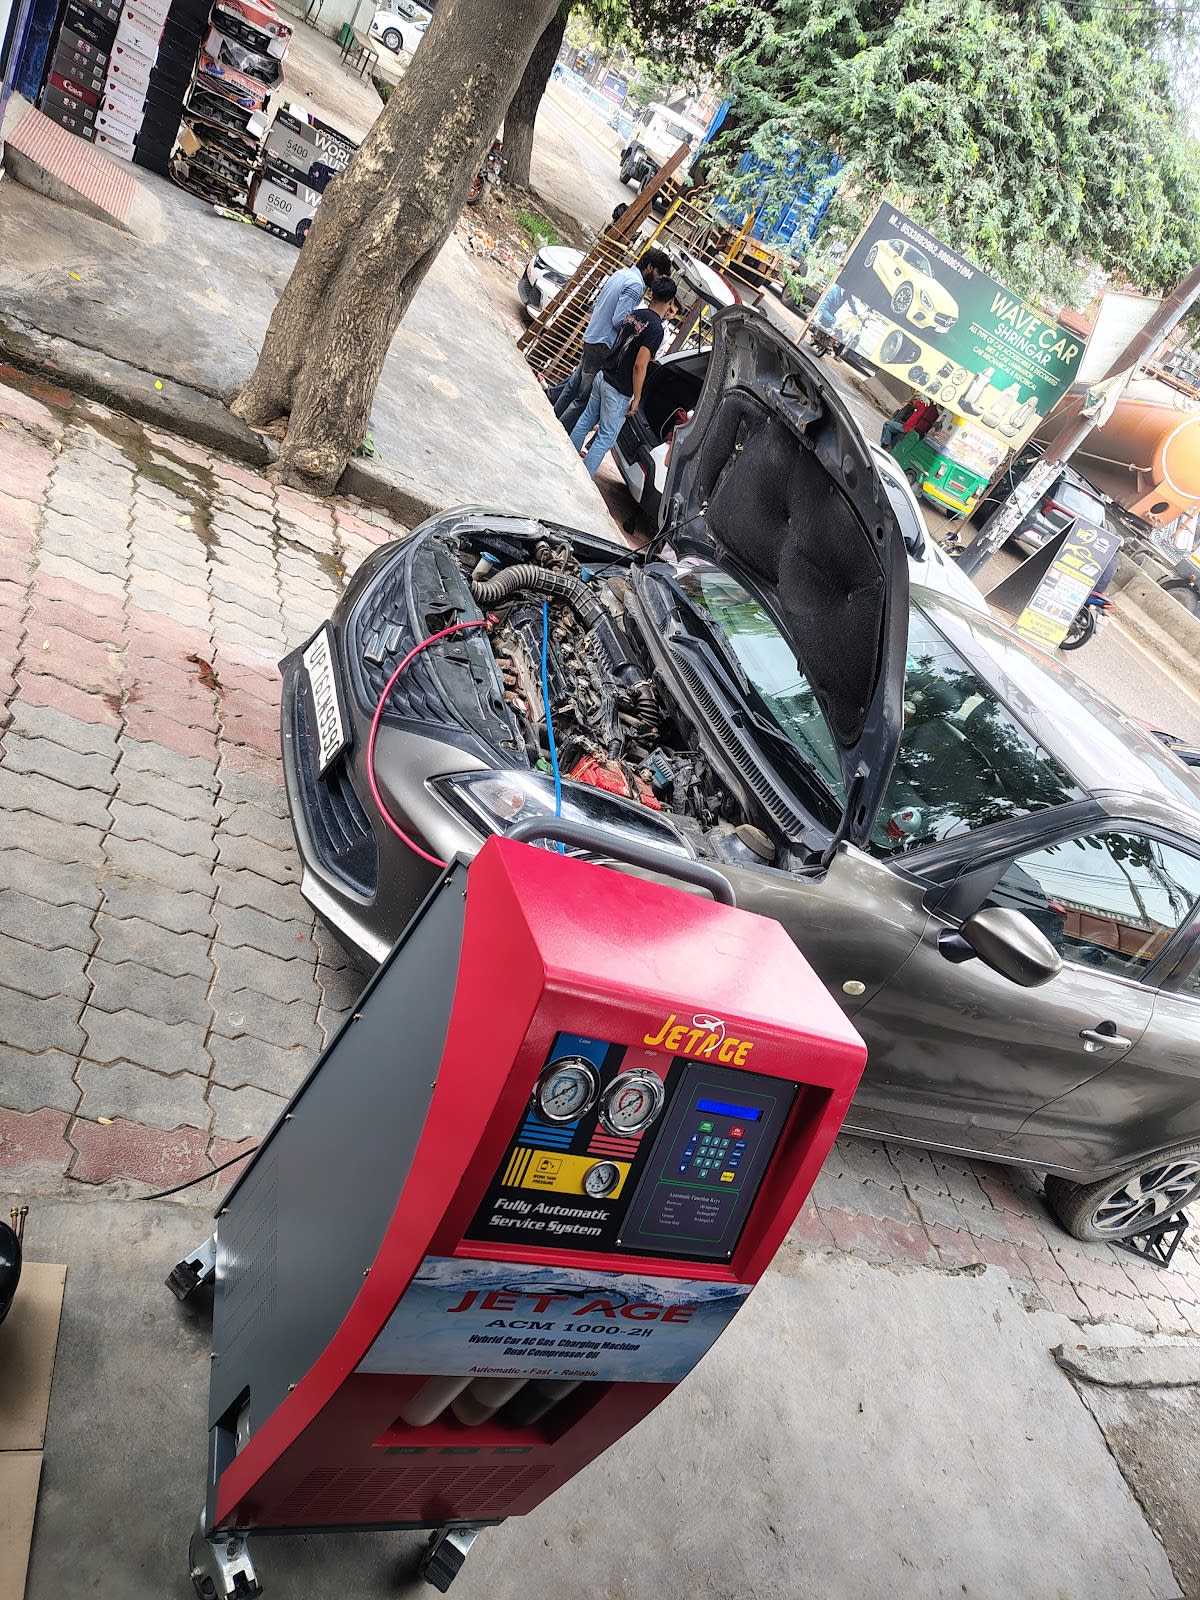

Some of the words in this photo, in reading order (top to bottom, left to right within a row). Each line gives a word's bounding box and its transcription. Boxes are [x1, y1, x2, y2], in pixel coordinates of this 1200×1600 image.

[286, 139, 308, 158] 5400
[315, 133, 350, 165] WORL
[268, 193, 293, 213] 6500
[990, 292, 1041, 338] WAVE
[1038, 329, 1079, 365] CAR
[994, 323, 1051, 366] SHRINGAR
[644, 1014, 754, 1066] JETAGE
[494, 1198, 532, 1214] Fully
[532, 1202, 611, 1221] Automatic
[489, 1215, 546, 1230] Service
[546, 1220, 602, 1236] System
[447, 1290, 568, 1313] JET
[572, 1299, 697, 1324] AGE
[485, 1319, 555, 1330] ACM
[562, 1323, 655, 1338] 1000-2H
[468, 1334, 505, 1344] Hybrid
[503, 1336, 522, 1346] Car
[522, 1337, 537, 1346] AC
[538, 1338, 555, 1347] Gas
[557, 1339, 601, 1350] Charging
[600, 1341, 641, 1351] Machine
[504, 1347, 527, 1356] Dual
[527, 1348, 585, 1359] Compressor
[585, 1351, 601, 1360] Oil
[468, 1366, 521, 1374] Automatic
[561, 1369, 599, 1377] Reliable
